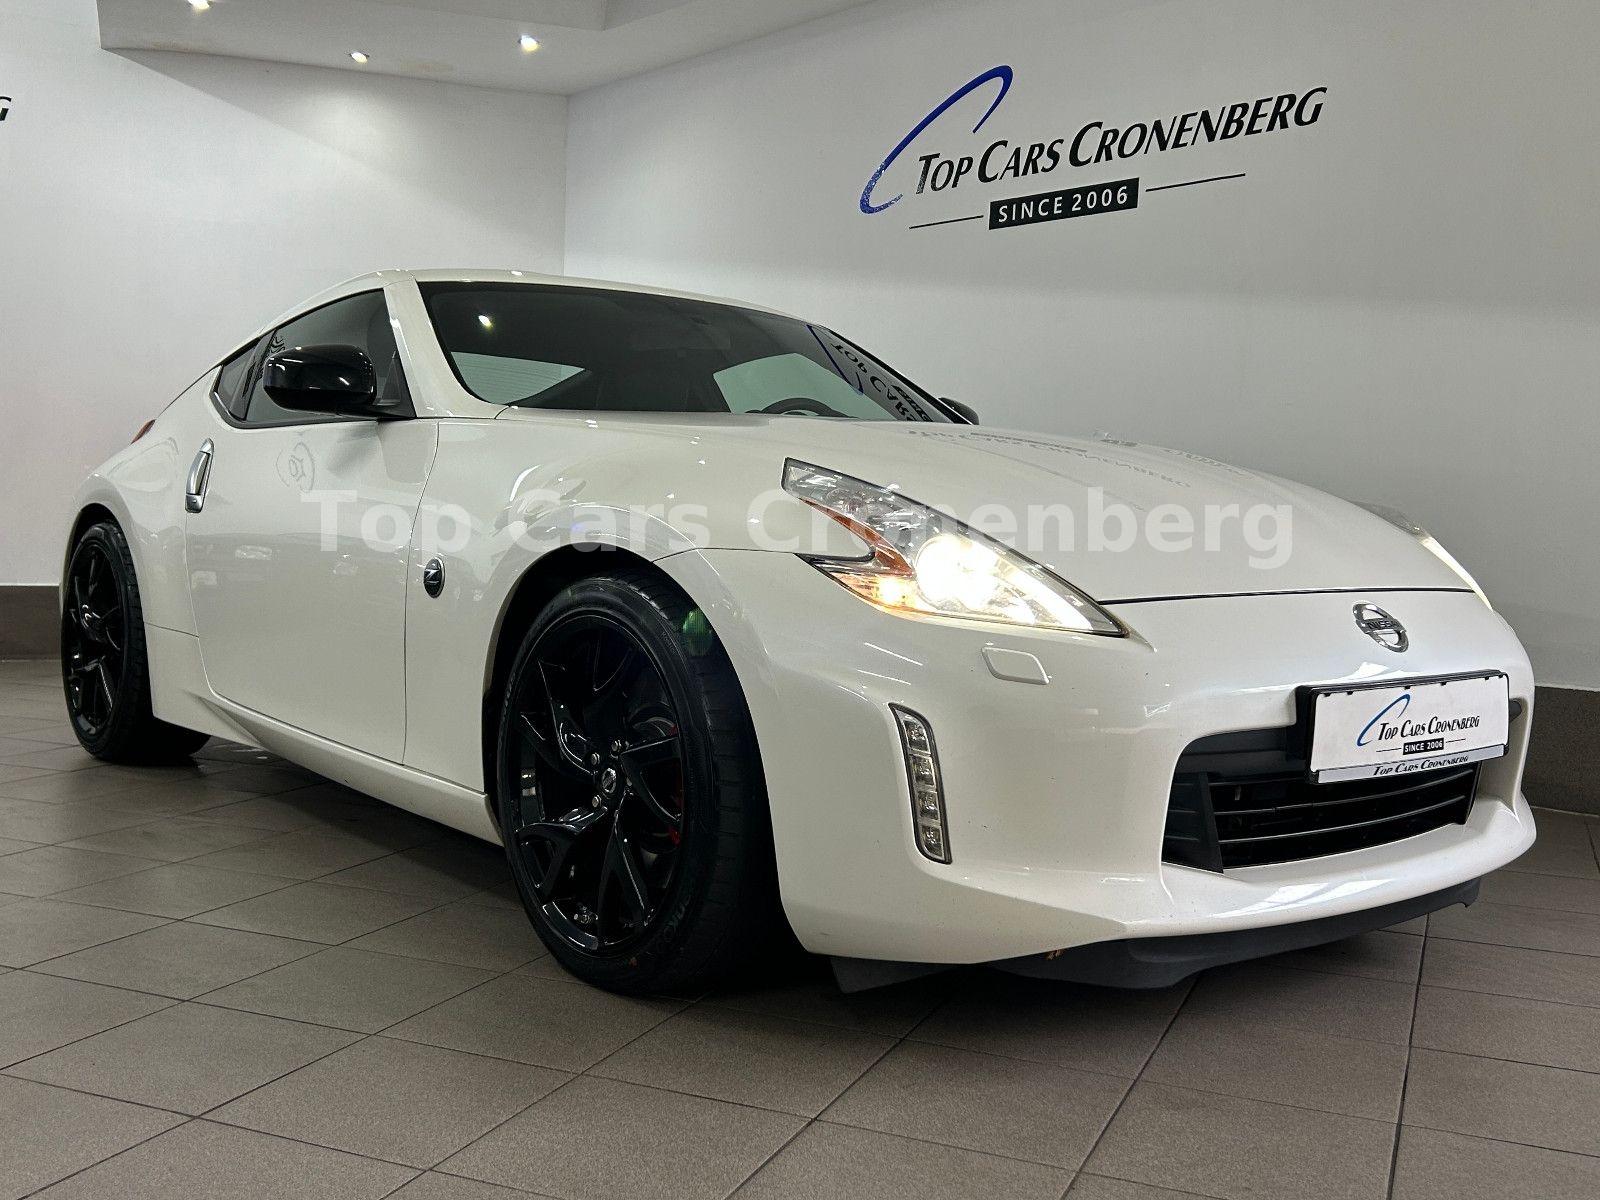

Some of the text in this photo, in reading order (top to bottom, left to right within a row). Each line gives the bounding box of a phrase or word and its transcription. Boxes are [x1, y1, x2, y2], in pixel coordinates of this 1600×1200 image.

[1068, 86, 1327, 167] CRONENBERG
[998, 185, 1128, 223] SINCE 2006
[1404, 739, 1443, 754] SINCE 2006
